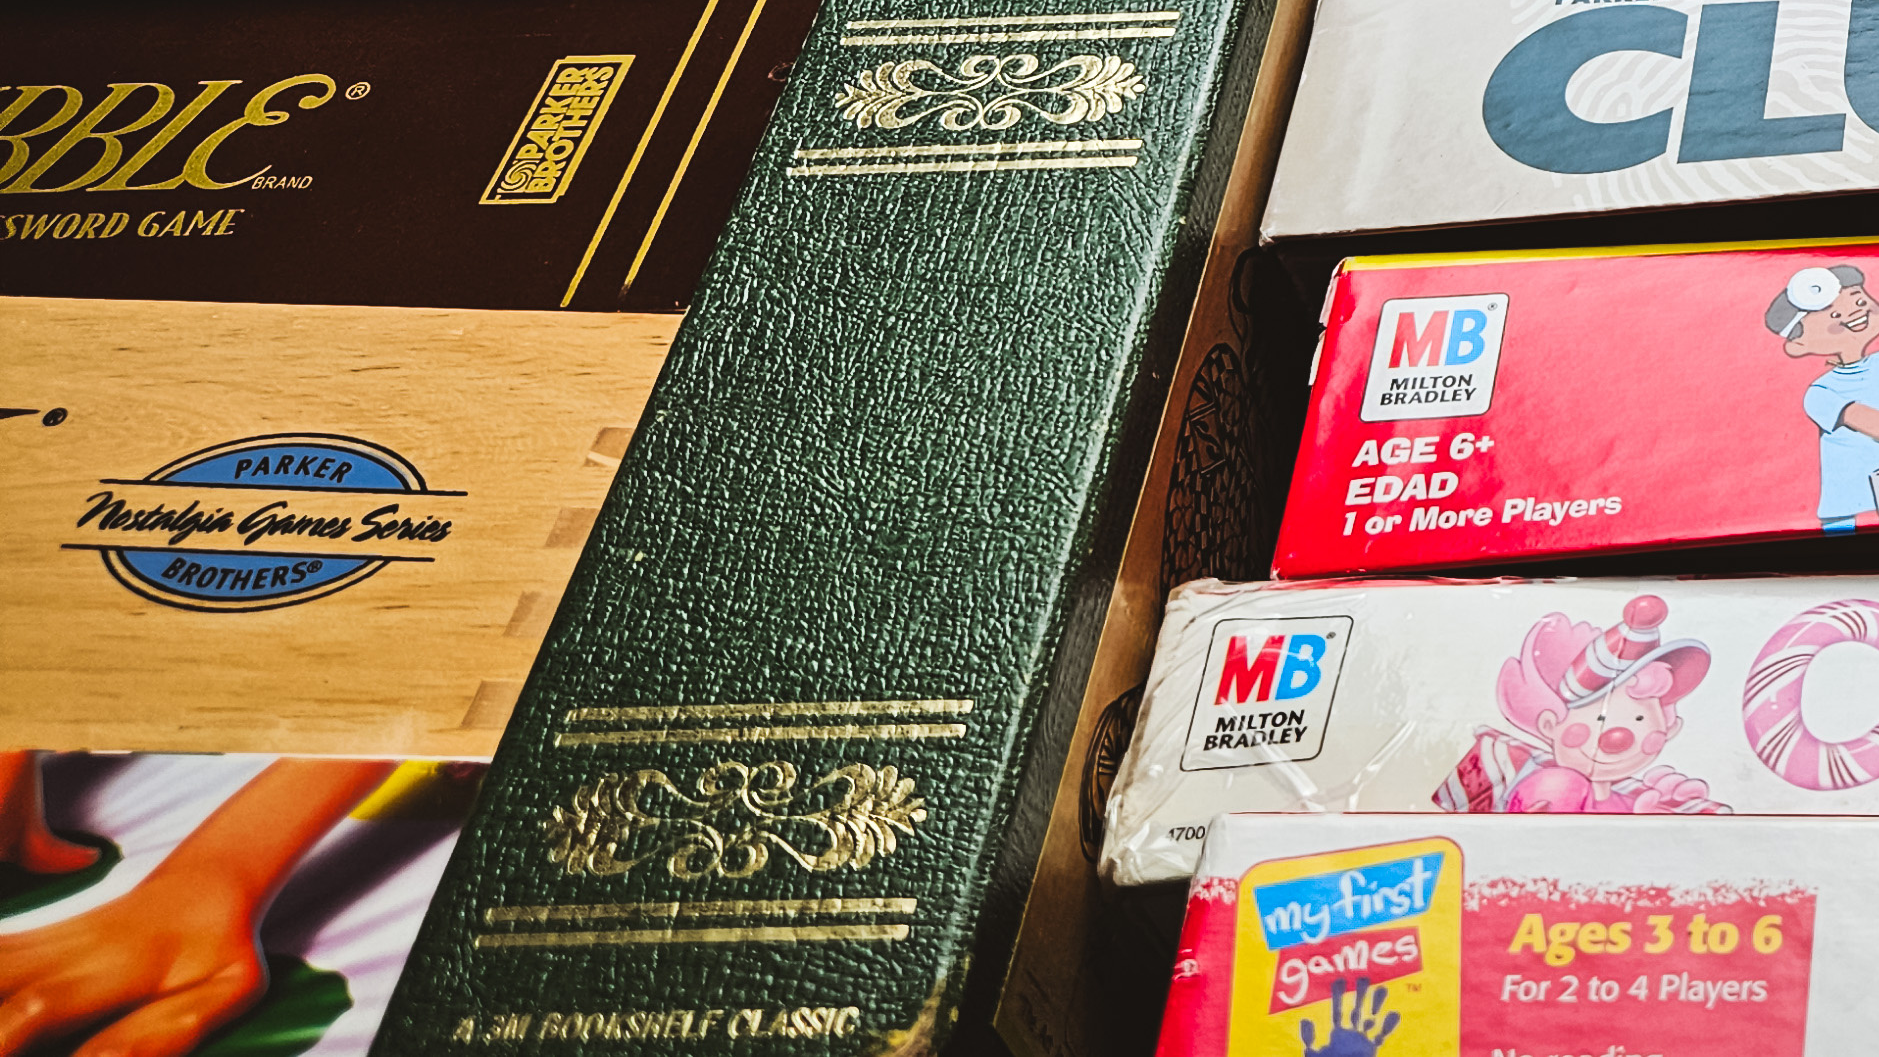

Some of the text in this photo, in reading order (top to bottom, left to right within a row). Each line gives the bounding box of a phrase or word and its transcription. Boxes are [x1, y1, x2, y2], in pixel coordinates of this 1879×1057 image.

[515, 66, 590, 160] PARKER
[524, 65, 614, 193] BROTHERS
[252, 174, 313, 192] BRAND
[0, 207, 245, 241] SWORD GAME
[1388, 308, 1489, 369] MB
[1380, 387, 1478, 406] BRADLEY
[1390, 373, 1474, 391] MILTON
[1351, 432, 1496, 467] AGE 6+
[234, 457, 353, 484] PARKER
[1345, 471, 1460, 506] EDAD
[77, 490, 454, 546] Nostalgia Games Series
[1343, 495, 1623, 536] 1 or More Players
[161, 557, 308, 591] BROTHERS
[1214, 634, 1327, 706] MB
[1203, 726, 1308, 751] BRADLEY
[1215, 709, 1305, 733] MILTON
[1263, 854, 1434, 945] my first
[1507, 913, 1783, 967] Ages 3 to 6
[1278, 930, 1420, 1004] games
[1500, 971, 1769, 1010] For 2 to 4 Players
[540, 1009, 725, 1041] BOOKSHELF
[727, 1006, 861, 1040] CLASSIC
